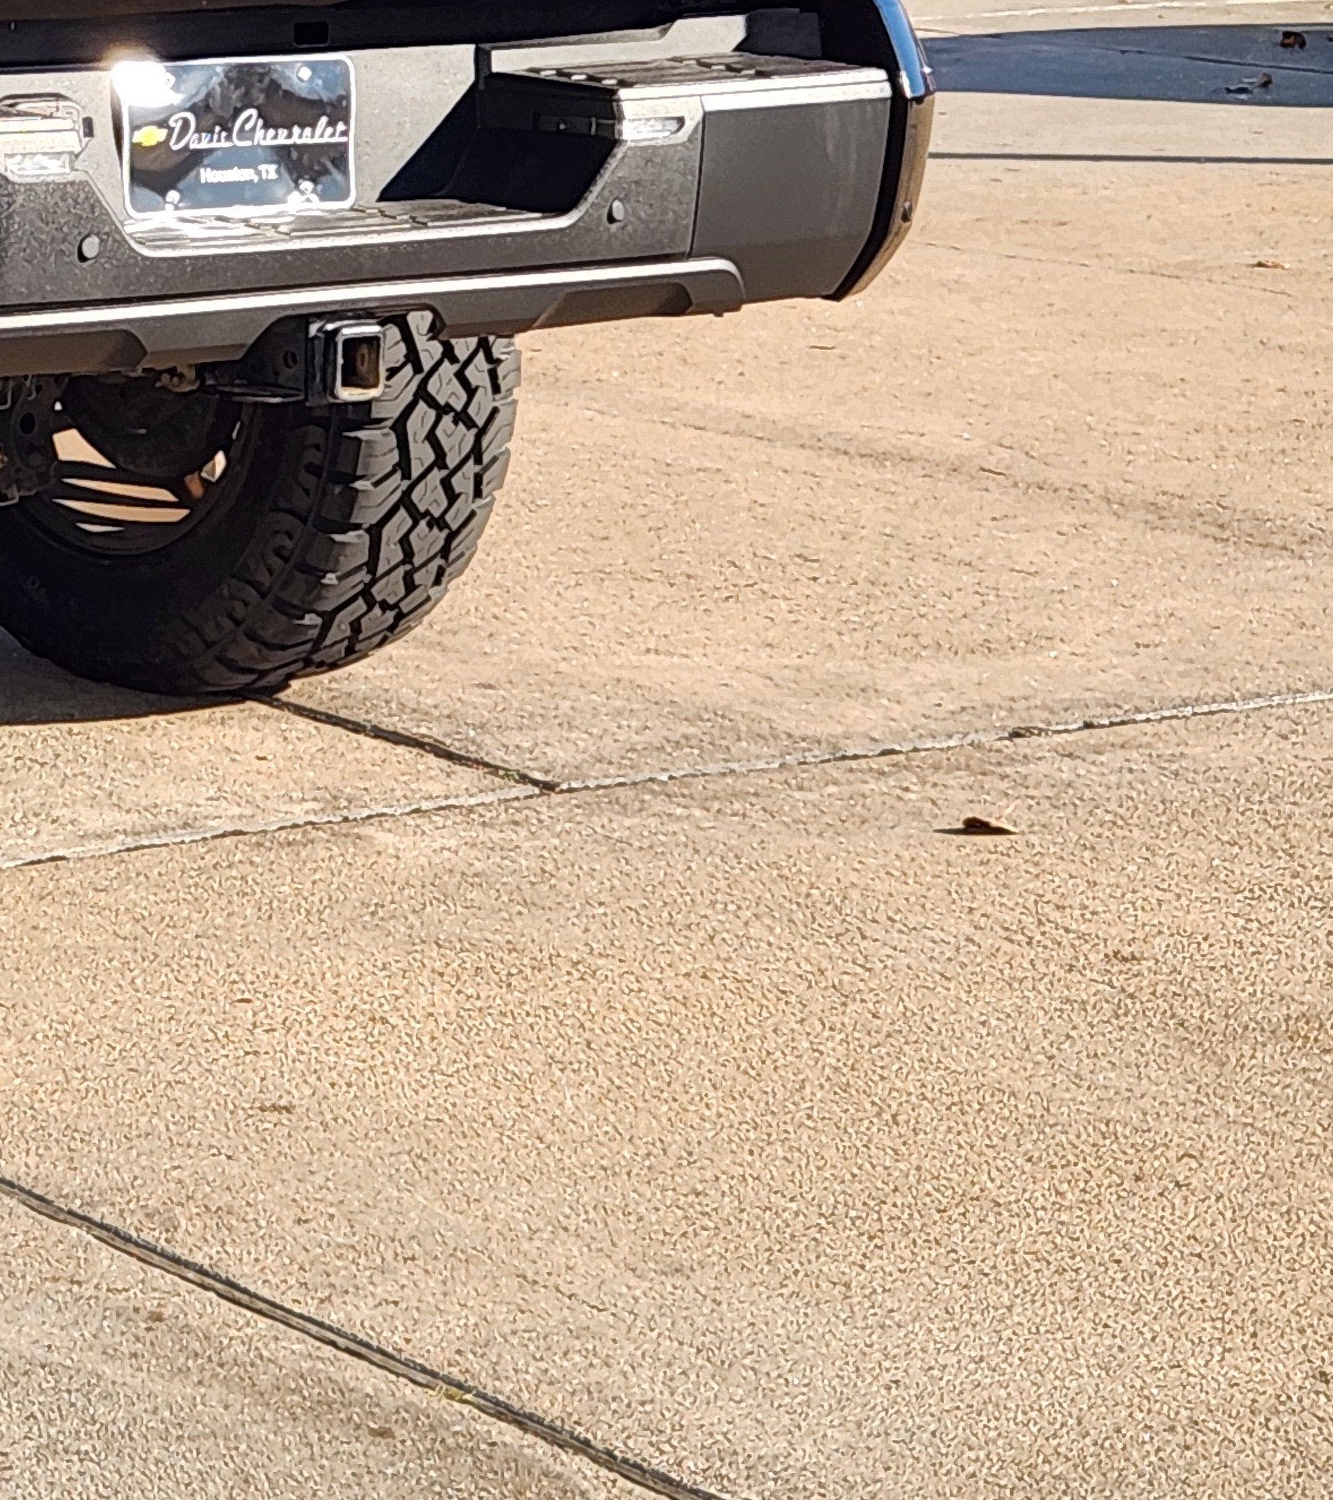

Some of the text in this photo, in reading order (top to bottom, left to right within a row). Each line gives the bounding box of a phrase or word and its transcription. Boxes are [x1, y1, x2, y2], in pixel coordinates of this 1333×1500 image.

[168, 108, 348, 151] Davis Chevrolet
[200, 163, 279, 184] Houston, TX
